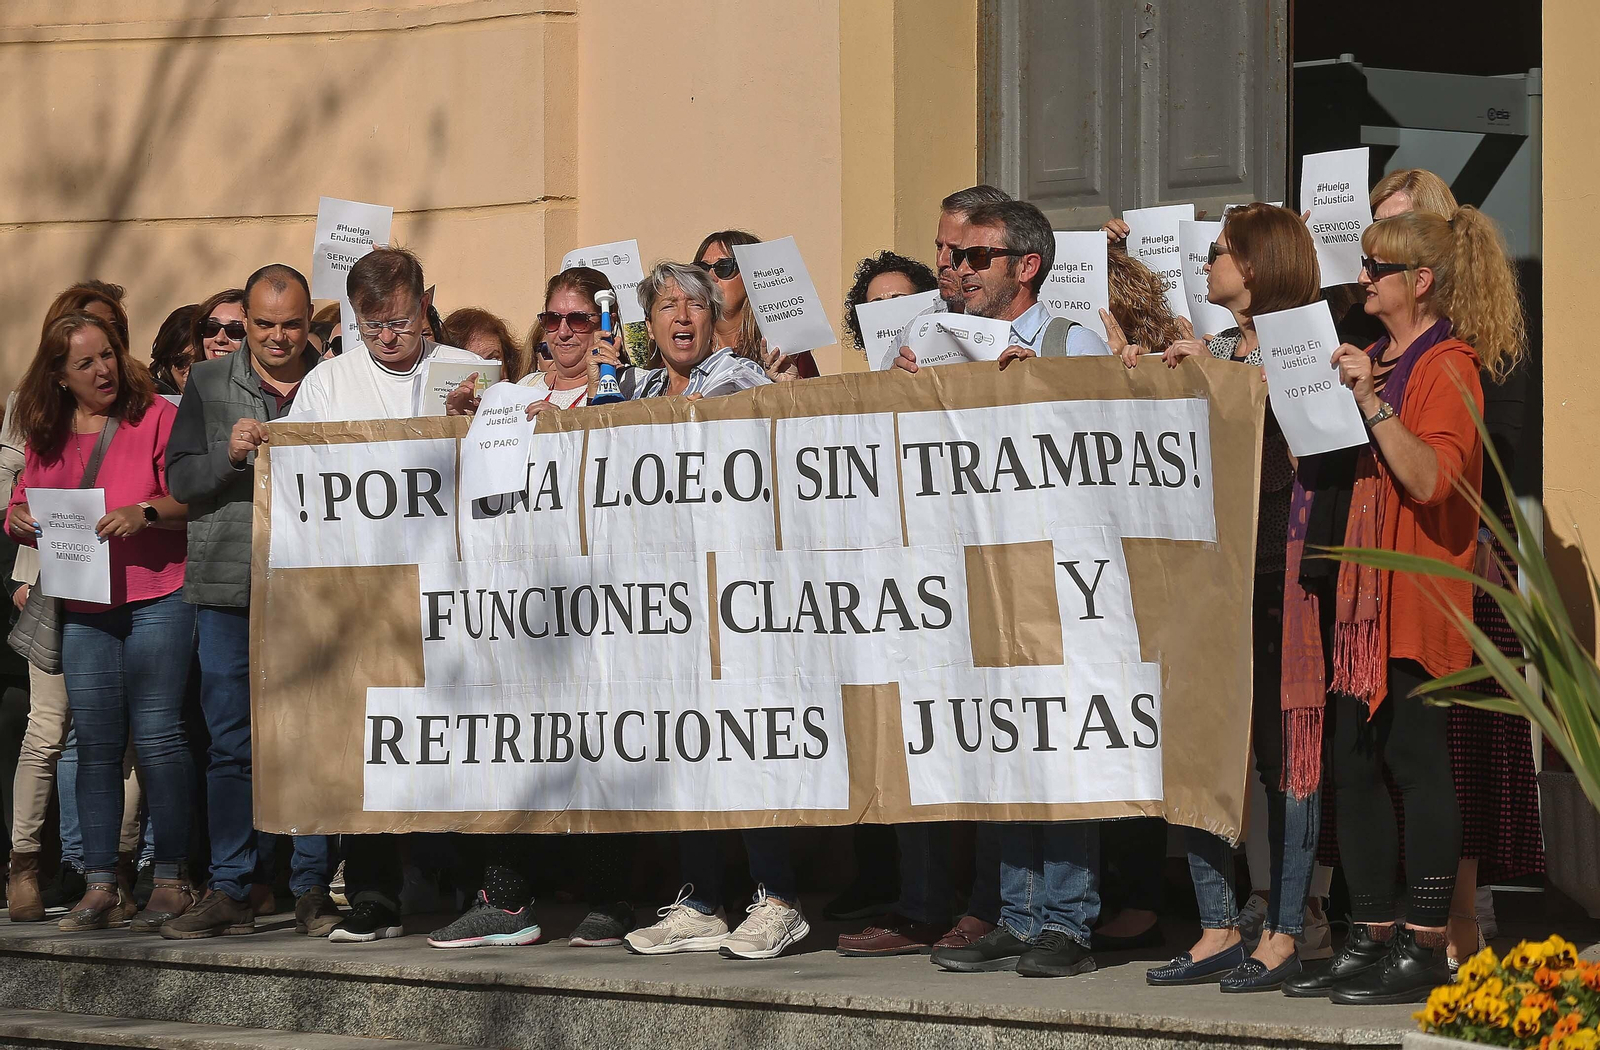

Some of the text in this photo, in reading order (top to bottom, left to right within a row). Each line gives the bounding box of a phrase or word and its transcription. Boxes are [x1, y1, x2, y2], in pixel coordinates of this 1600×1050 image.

[1317, 182, 1350, 193] #Huelga
[1314, 194, 1354, 206] EnJusticia
[336, 224, 370, 236] #Huelga
[1313, 220, 1361, 233] SERVICIOS
[330, 232, 374, 245] EnJusticia
[1141, 234, 1174, 245] #Huelga
[1139, 245, 1180, 257] EnJusticia
[327, 252, 360, 264] SERVIC
[753, 267, 785, 279] #Huelga
[1051, 262, 1093, 273] uelga En
[753, 275, 794, 290] EnJusticia
[1050, 274, 1085, 283] Justicia
[758, 295, 804, 313] SERVICIOS
[1048, 300, 1091, 310] YO PARO
[1271, 340, 1322, 358] #Huelga En
[1281, 355, 1317, 370] Justicia
[1284, 380, 1332, 399] YO PARO
[481, 407, 514, 417] #Huelga
[486, 416, 518, 426] Justicia
[479, 438, 519, 450] YO PARO
[592, 449, 771, 508] L.O.E.O.
[796, 444, 881, 501] SIN
[902, 431, 1201, 497] TRAMPAS!
[51, 512, 85, 522] #Huelga
[49, 521, 92, 530] EnJusticia
[51, 541, 96, 553] SERVICIOS
[422, 559, 1110, 641] FUNCIONES CLARAS Y
[366, 693, 1159, 765] RETRIBUCIONES JUSTAS
